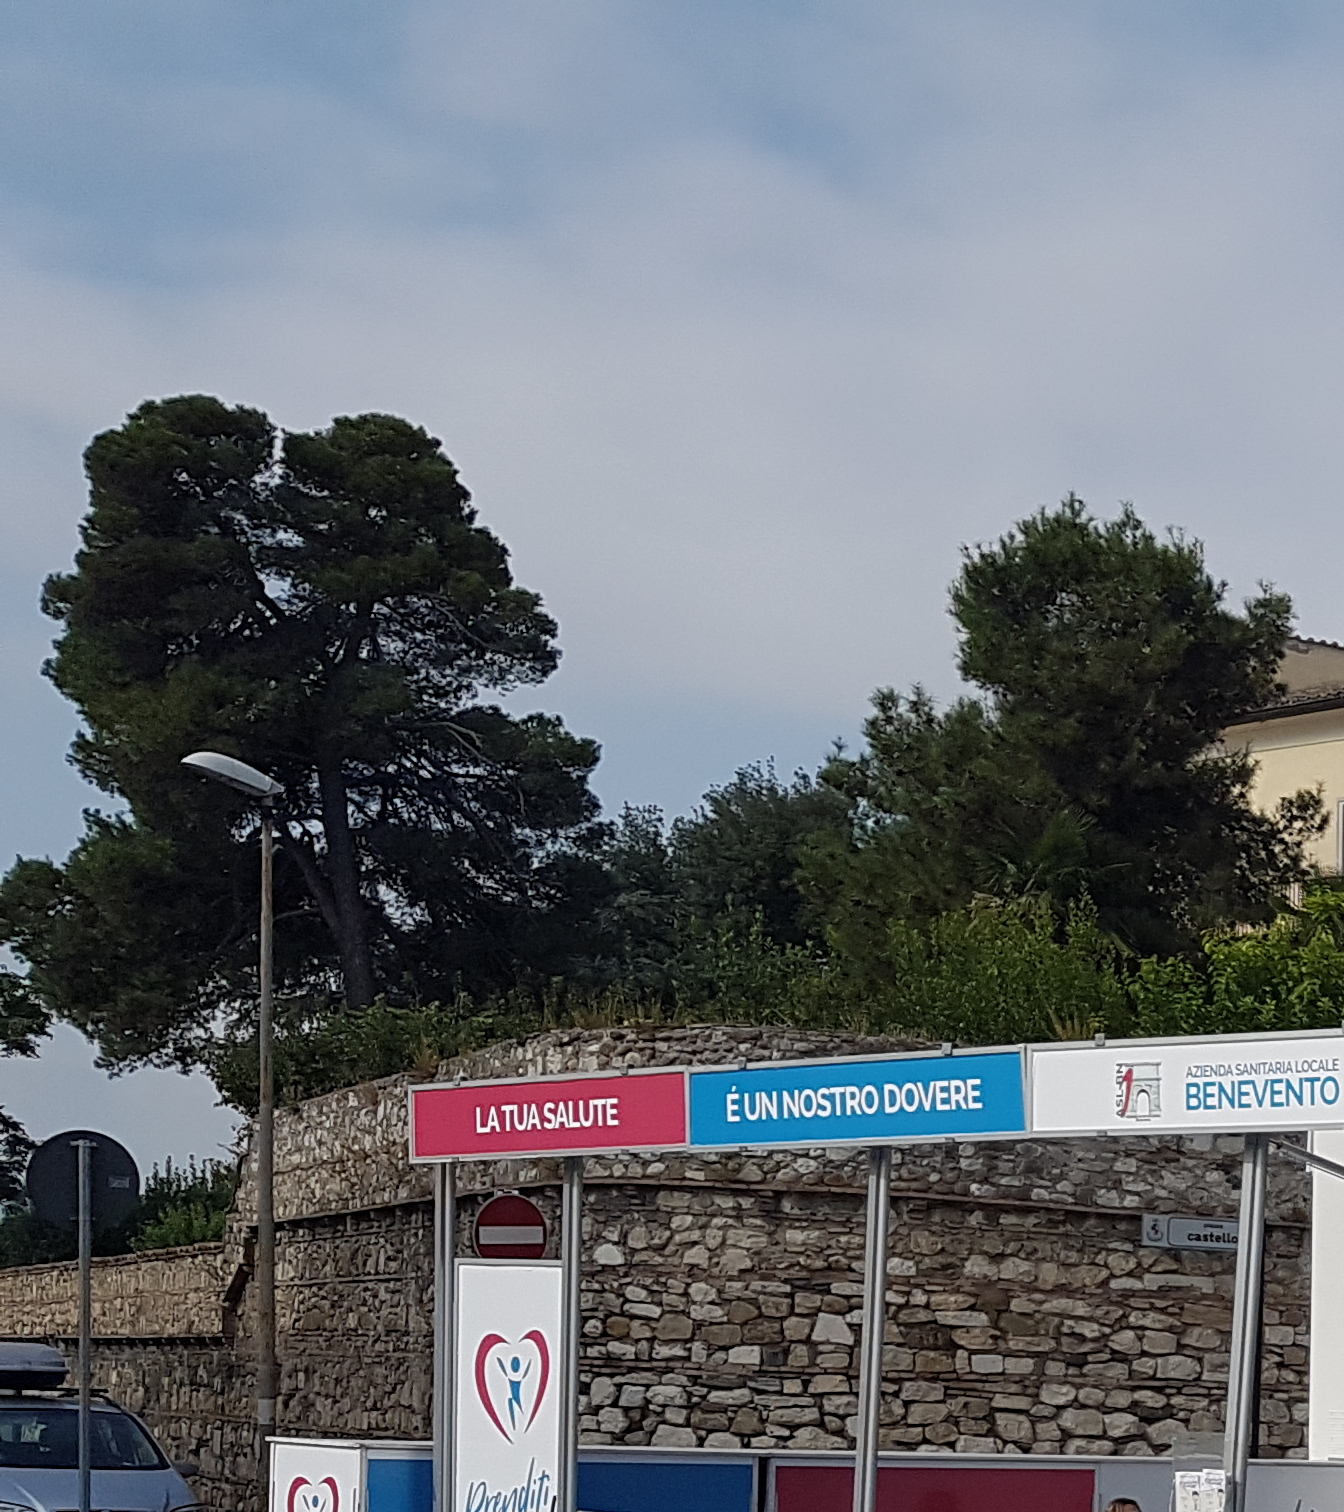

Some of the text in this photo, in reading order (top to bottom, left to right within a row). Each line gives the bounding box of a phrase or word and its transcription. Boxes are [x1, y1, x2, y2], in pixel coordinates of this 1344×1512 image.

[1186, 1058, 1339, 1078] AZIENDA SANITARIA LOCALE
[744, 1091, 778, 1120] UN
[782, 1085, 879, 1119] NOSTRO
[883, 1079, 983, 1114] DOVERE
[1185, 1076, 1340, 1111] BENEVENTO
[476, 1098, 619, 1133] LA TUA SALUTE
